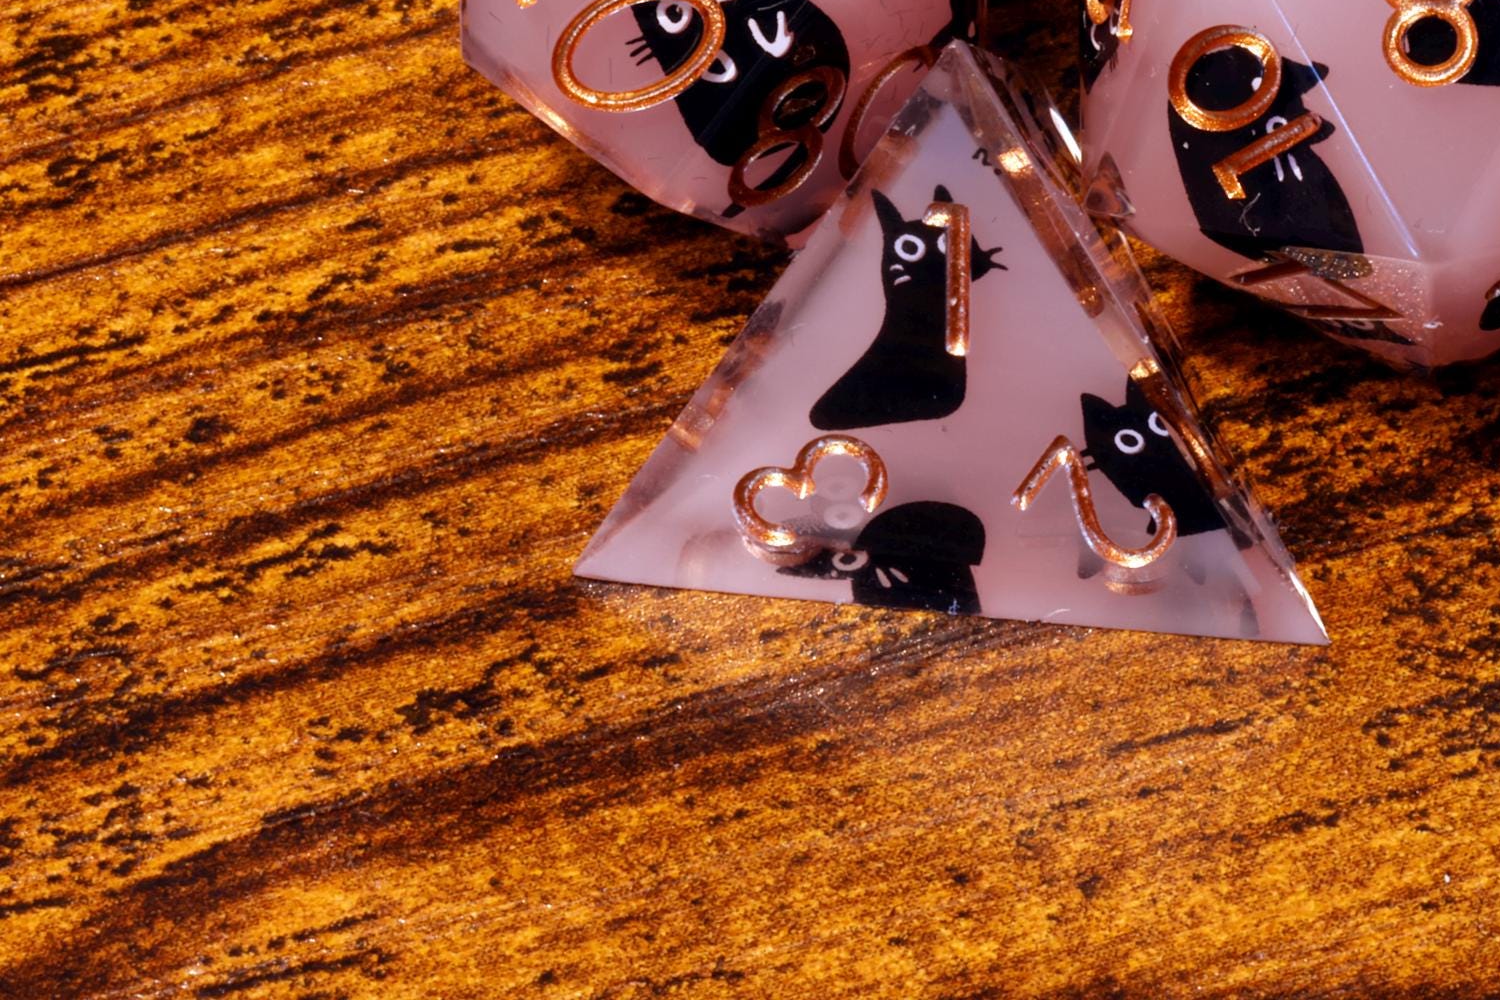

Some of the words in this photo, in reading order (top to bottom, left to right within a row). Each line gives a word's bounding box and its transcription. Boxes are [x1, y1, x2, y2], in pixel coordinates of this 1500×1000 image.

[1167, 23, 1322, 200] 10
[922, 201, 972, 357] 1
[732, 435, 888, 552] 3
[1011, 435, 1177, 572] 2
